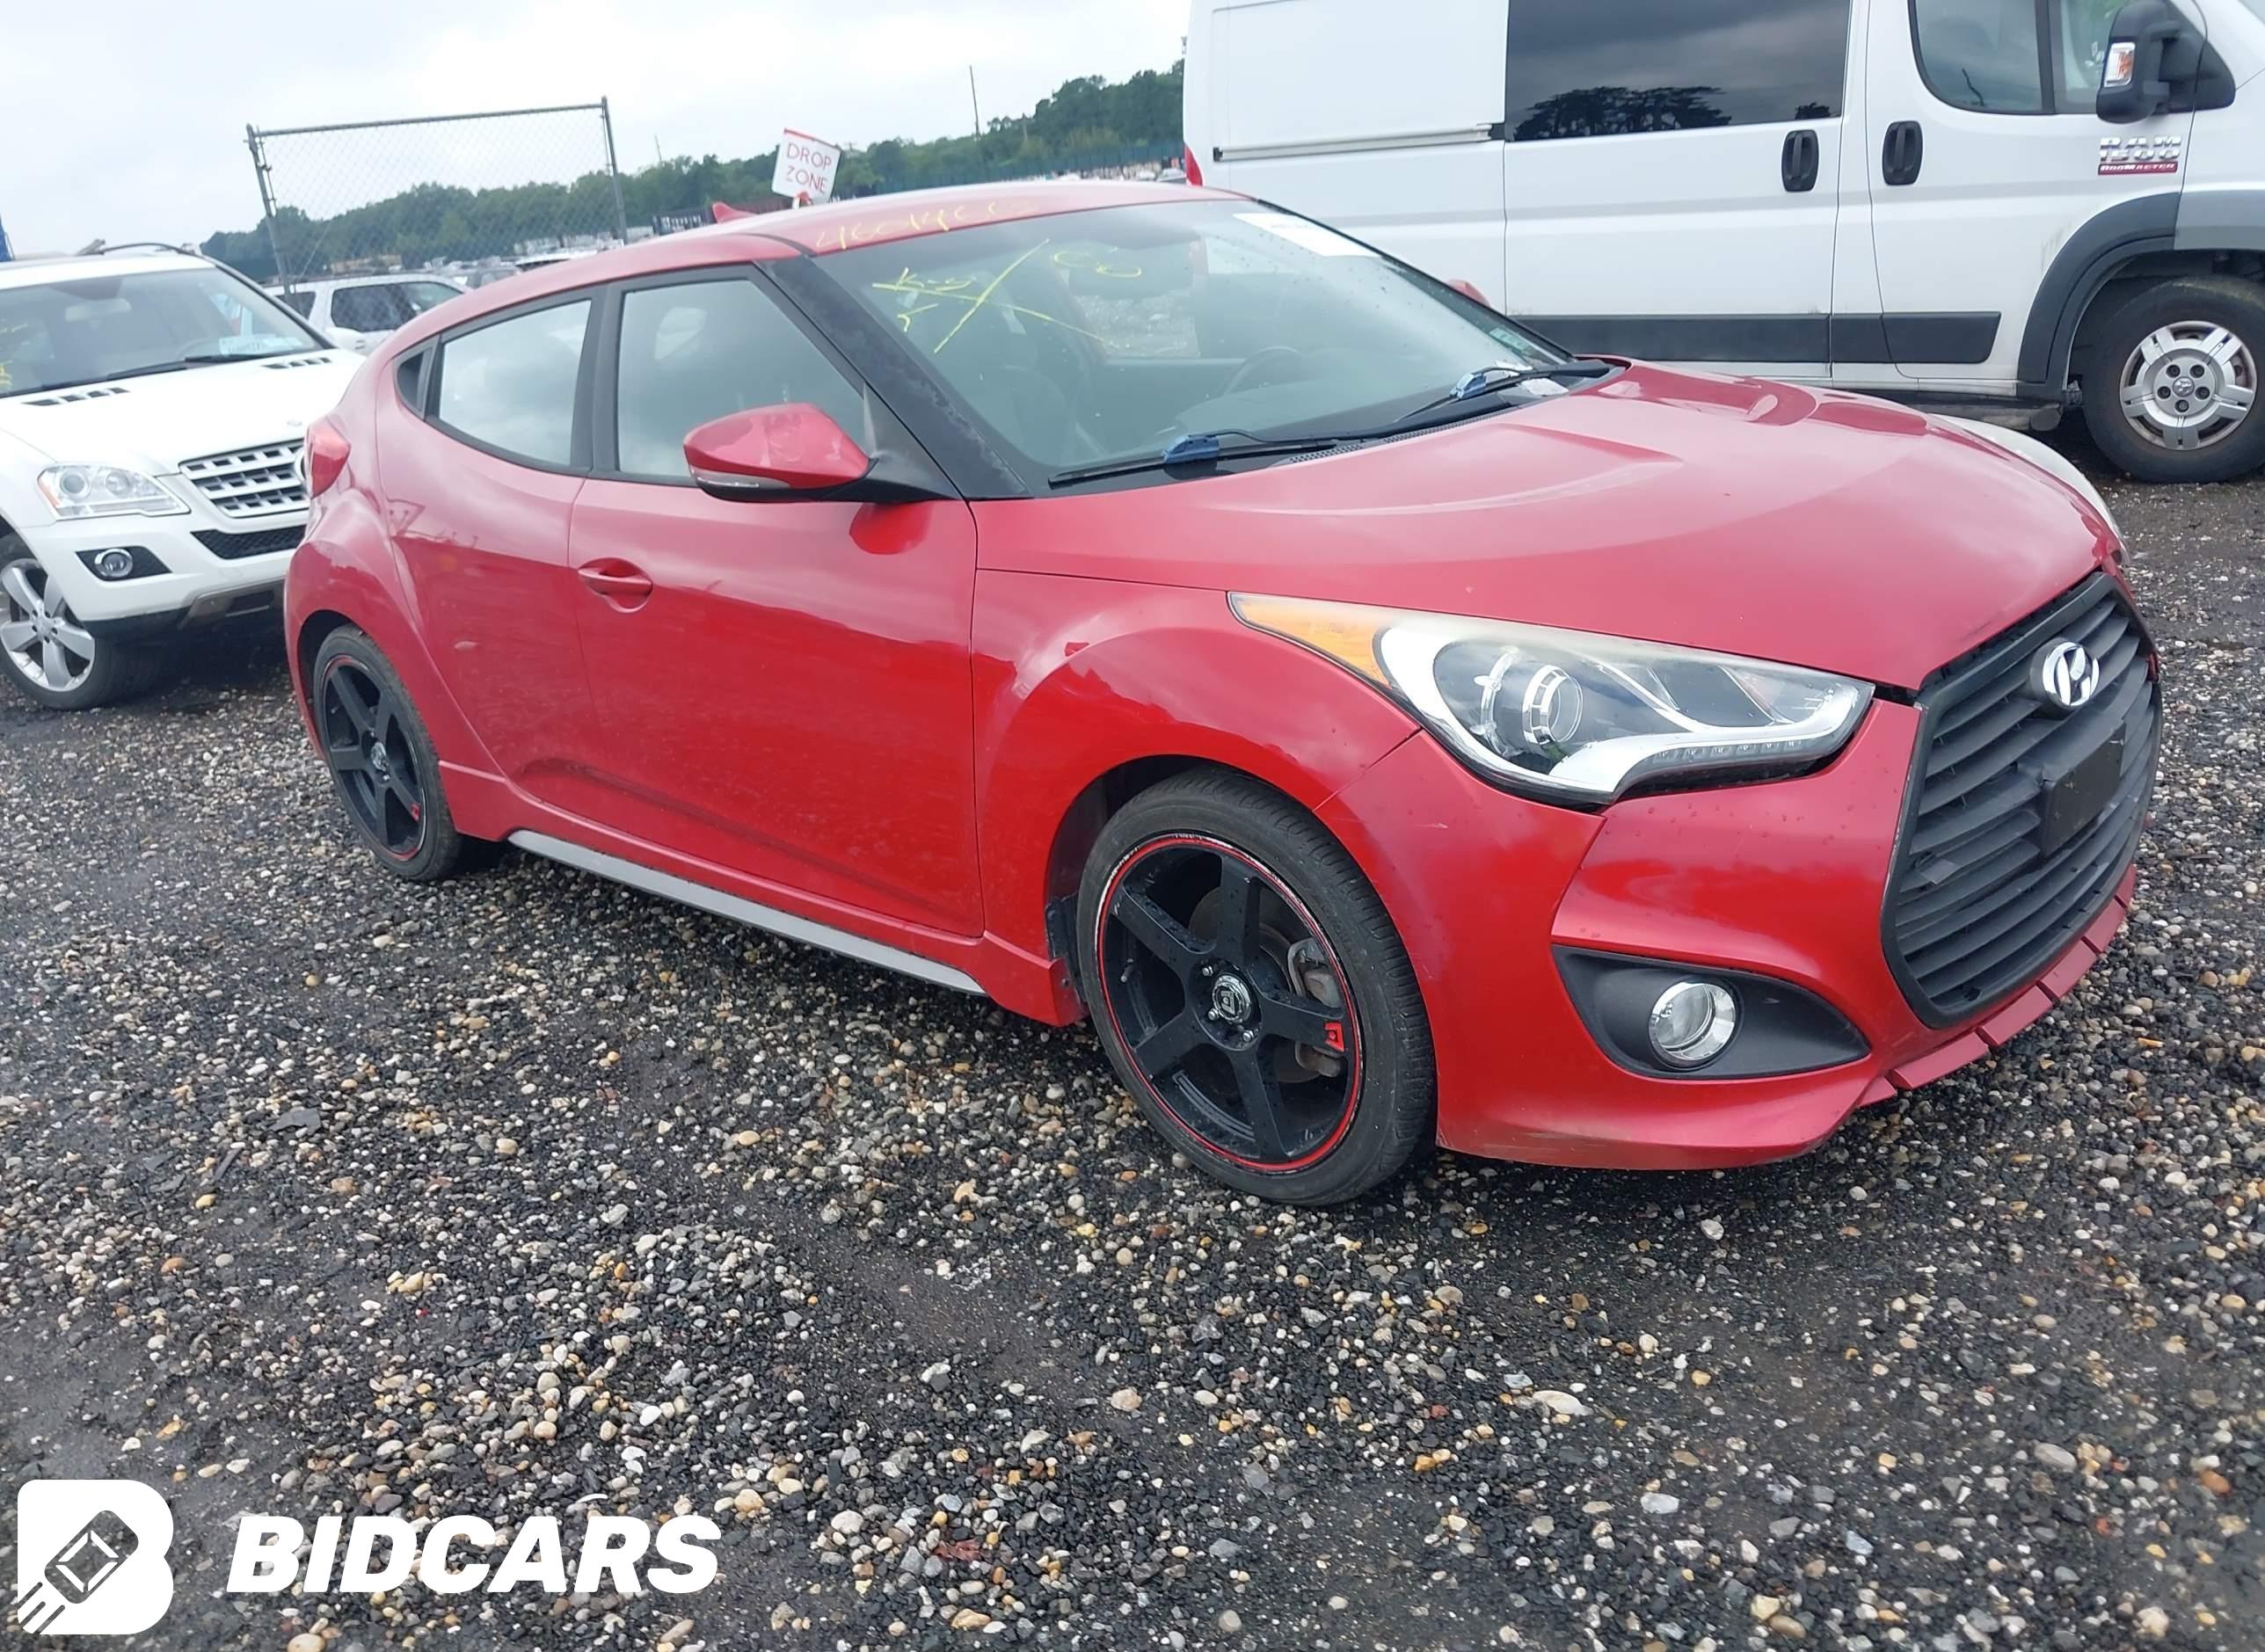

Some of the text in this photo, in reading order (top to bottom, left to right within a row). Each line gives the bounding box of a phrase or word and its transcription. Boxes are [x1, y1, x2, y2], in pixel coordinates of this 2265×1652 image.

[2100, 136, 2181, 149] RAM
[787, 142, 832, 171] DROP
[2099, 149, 2181, 162] 1500
[785, 165, 828, 193] ZONE
